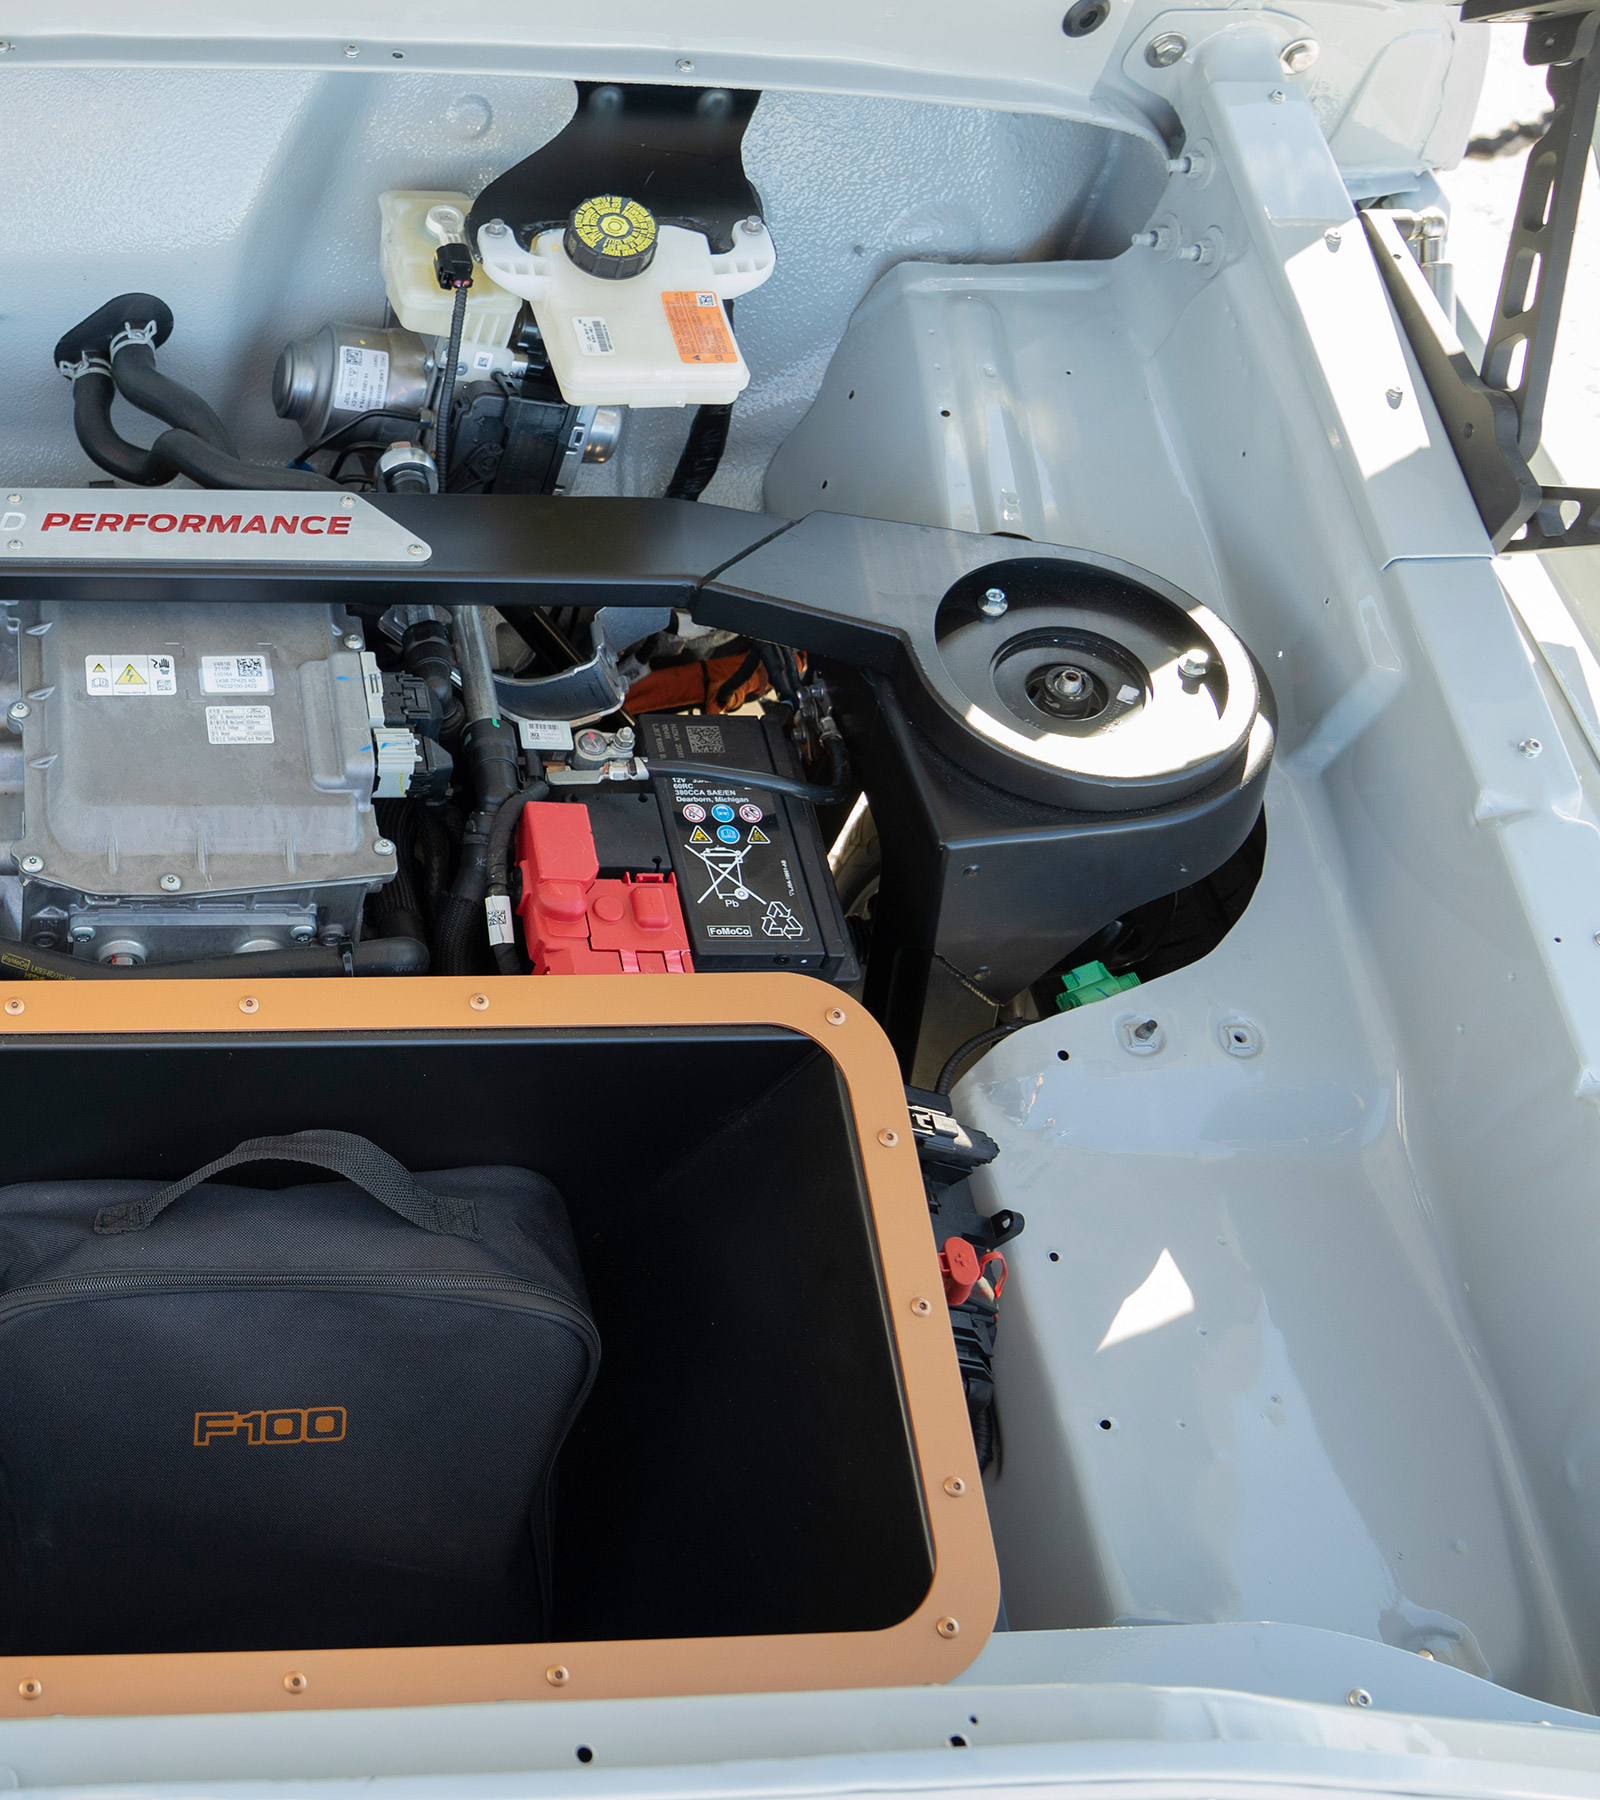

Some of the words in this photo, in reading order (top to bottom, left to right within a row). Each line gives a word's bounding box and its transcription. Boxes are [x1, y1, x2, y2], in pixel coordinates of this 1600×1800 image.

[40, 512, 352, 535] PERFORMANCE
[714, 796, 750, 804] Michigan
[725, 899, 740, 908] Pb
[709, 927, 750, 935] FoMoCo
[193, 1406, 347, 1446] F100
